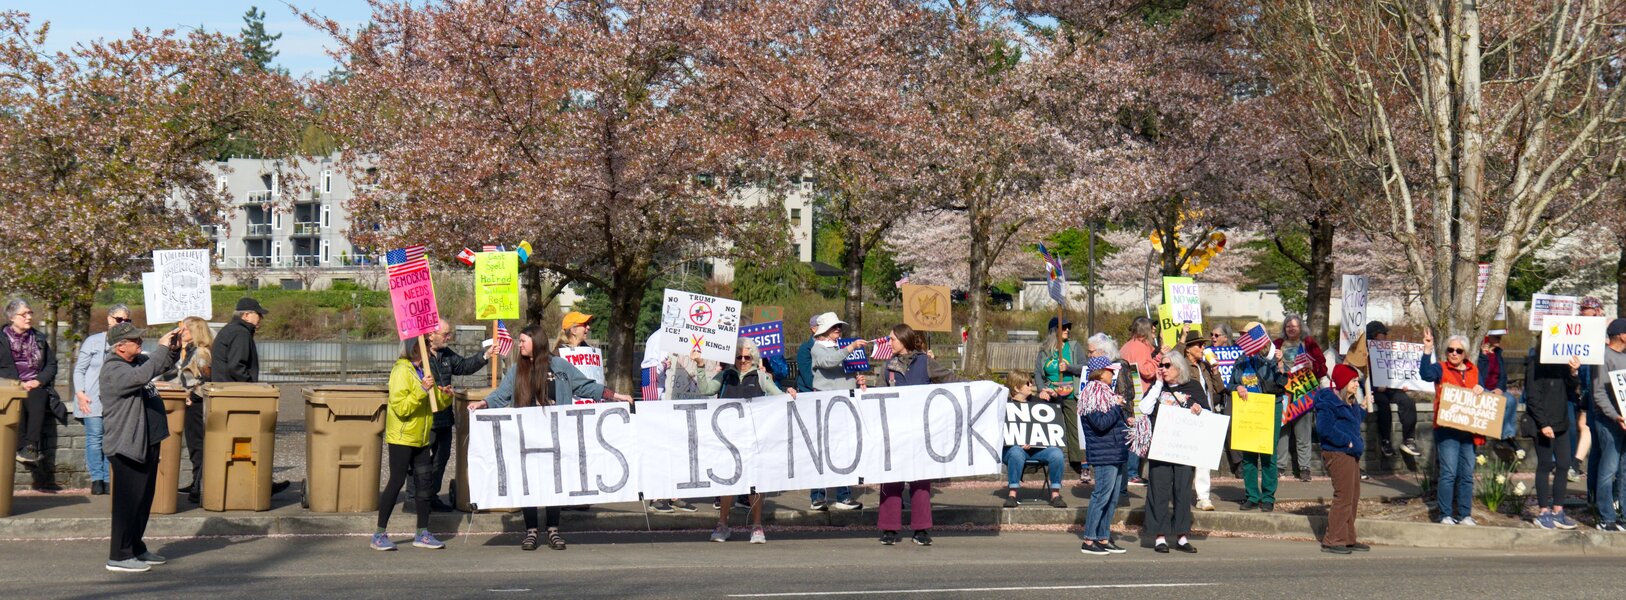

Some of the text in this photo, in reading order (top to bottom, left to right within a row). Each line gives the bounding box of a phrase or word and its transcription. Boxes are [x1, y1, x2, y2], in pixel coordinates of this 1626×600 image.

[389, 268, 430, 290] DEMOCRACY
[480, 272, 512, 283] Hatred
[1172, 285, 1197, 295] NO ICE
[1350, 278, 1363, 292] NO
[403, 285, 430, 301] NEEDS
[689, 294, 716, 304] TRUMP
[1173, 295, 1199, 304] NO WAR
[400, 298, 431, 317] YOUR
[400, 312, 439, 332] COURAGE
[1348, 312, 1362, 326] NO
[665, 327, 680, 335] ICE!
[685, 323, 716, 335] BUSTERS
[717, 324, 737, 333] WAR!
[1566, 323, 1581, 336] NO
[752, 333, 780, 347] SIST!
[1369, 340, 1397, 350] ABUSE
[845, 349, 866, 361] SIST!
[1377, 350, 1421, 359] THREATEN
[1552, 343, 1590, 356] KINGS
[565, 353, 601, 367] IMPEACH
[1290, 371, 1314, 390] ARE
[1386, 369, 1418, 380] LIBER
[1294, 380, 1320, 400] ALL
[1006, 402, 1056, 423] NO
[1439, 409, 1489, 429] DEFUND ICE
[475, 385, 1003, 497] THIS IS NOT OK
[1003, 422, 1066, 447] WAR
